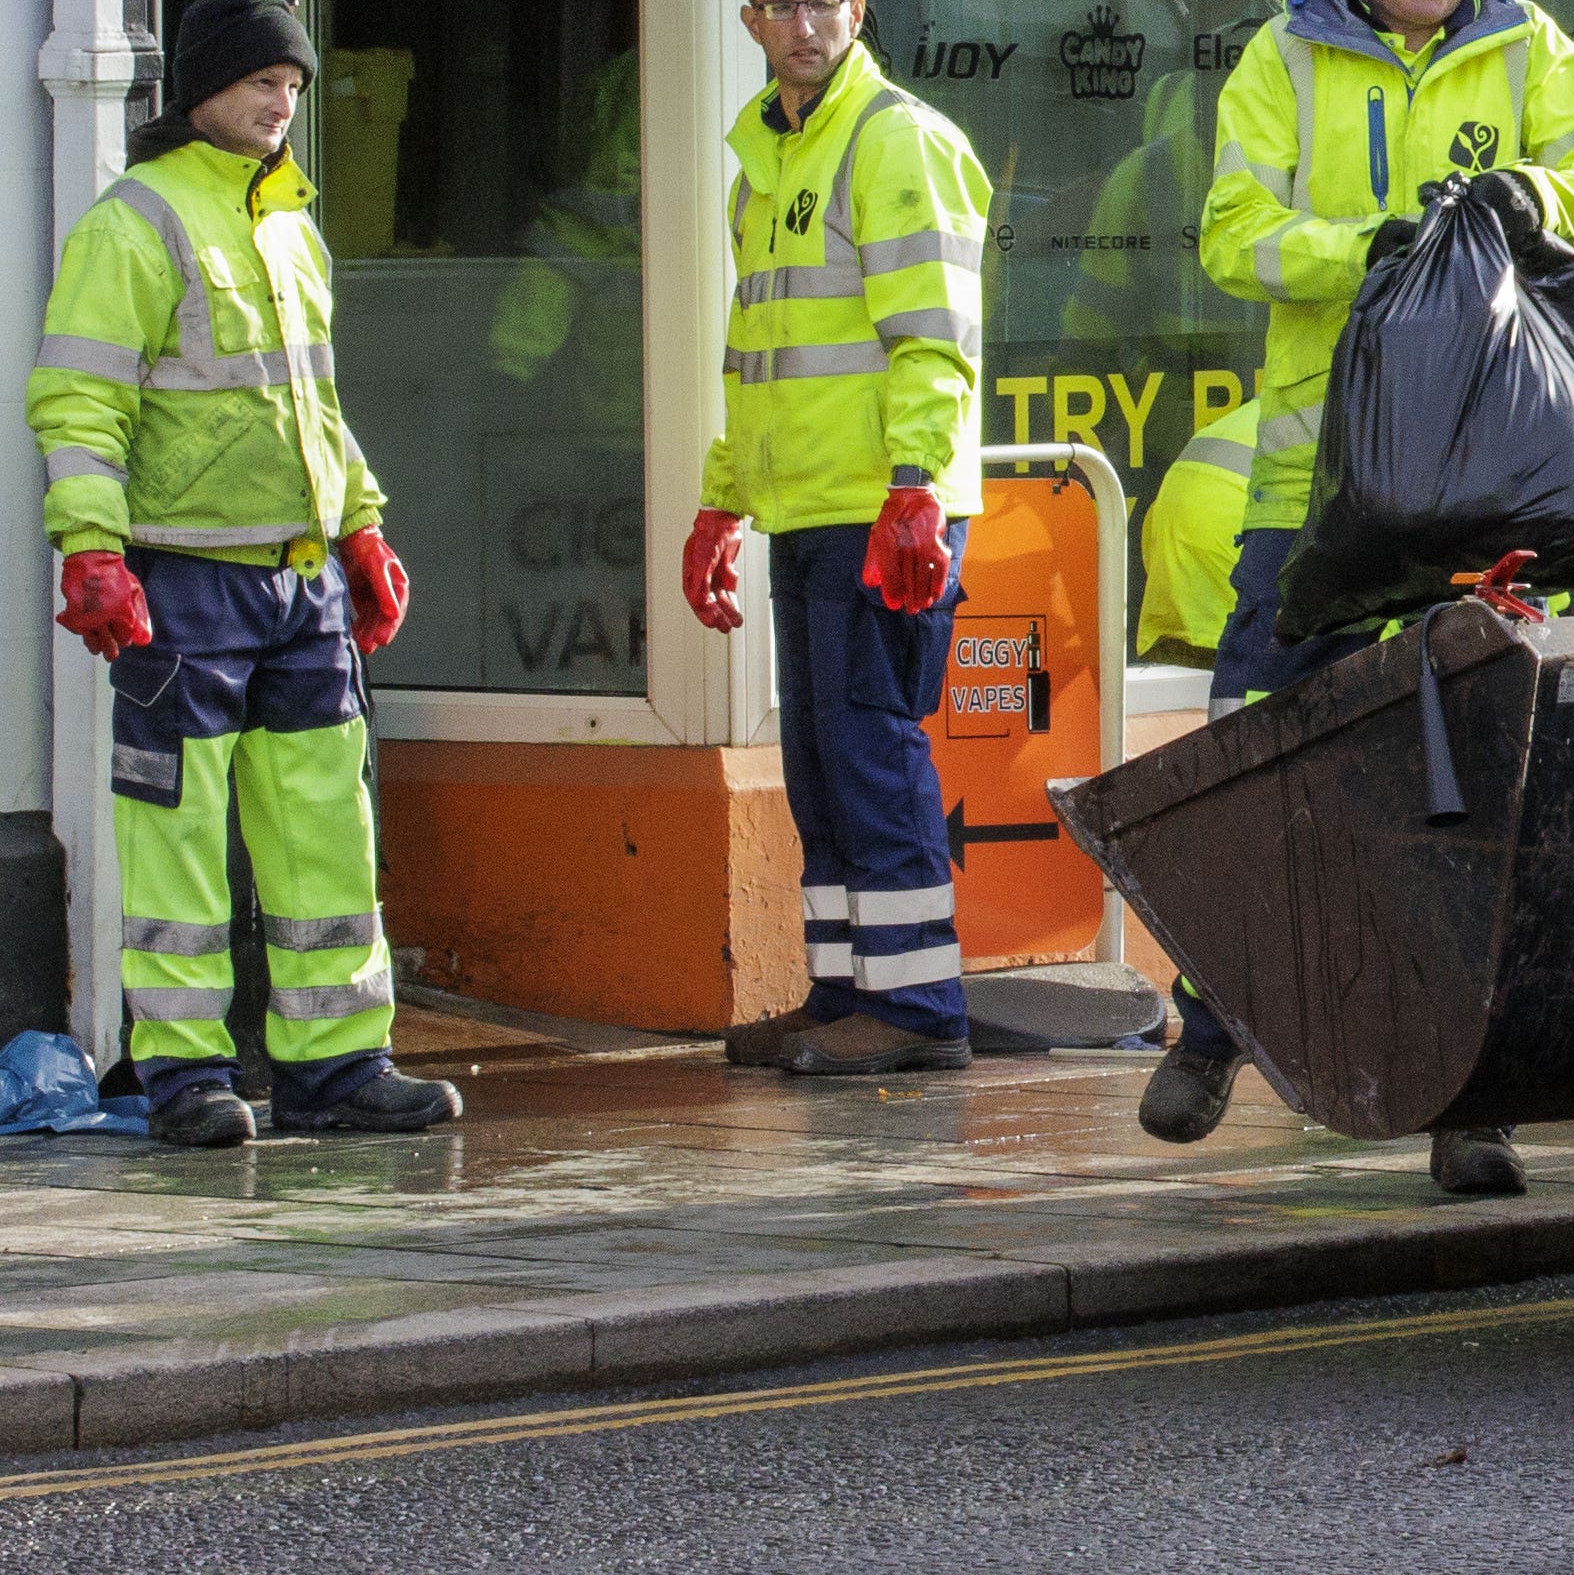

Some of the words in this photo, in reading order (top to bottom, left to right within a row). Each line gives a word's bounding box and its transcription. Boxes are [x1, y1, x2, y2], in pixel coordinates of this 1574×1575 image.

[1193, 33, 1243, 71] Ele
[1051, 234, 1150, 249] NITECORE
[996, 371, 1165, 474] TRY
[955, 637, 1028, 668] CIGGY
[951, 684, 1028, 714] VAPES
